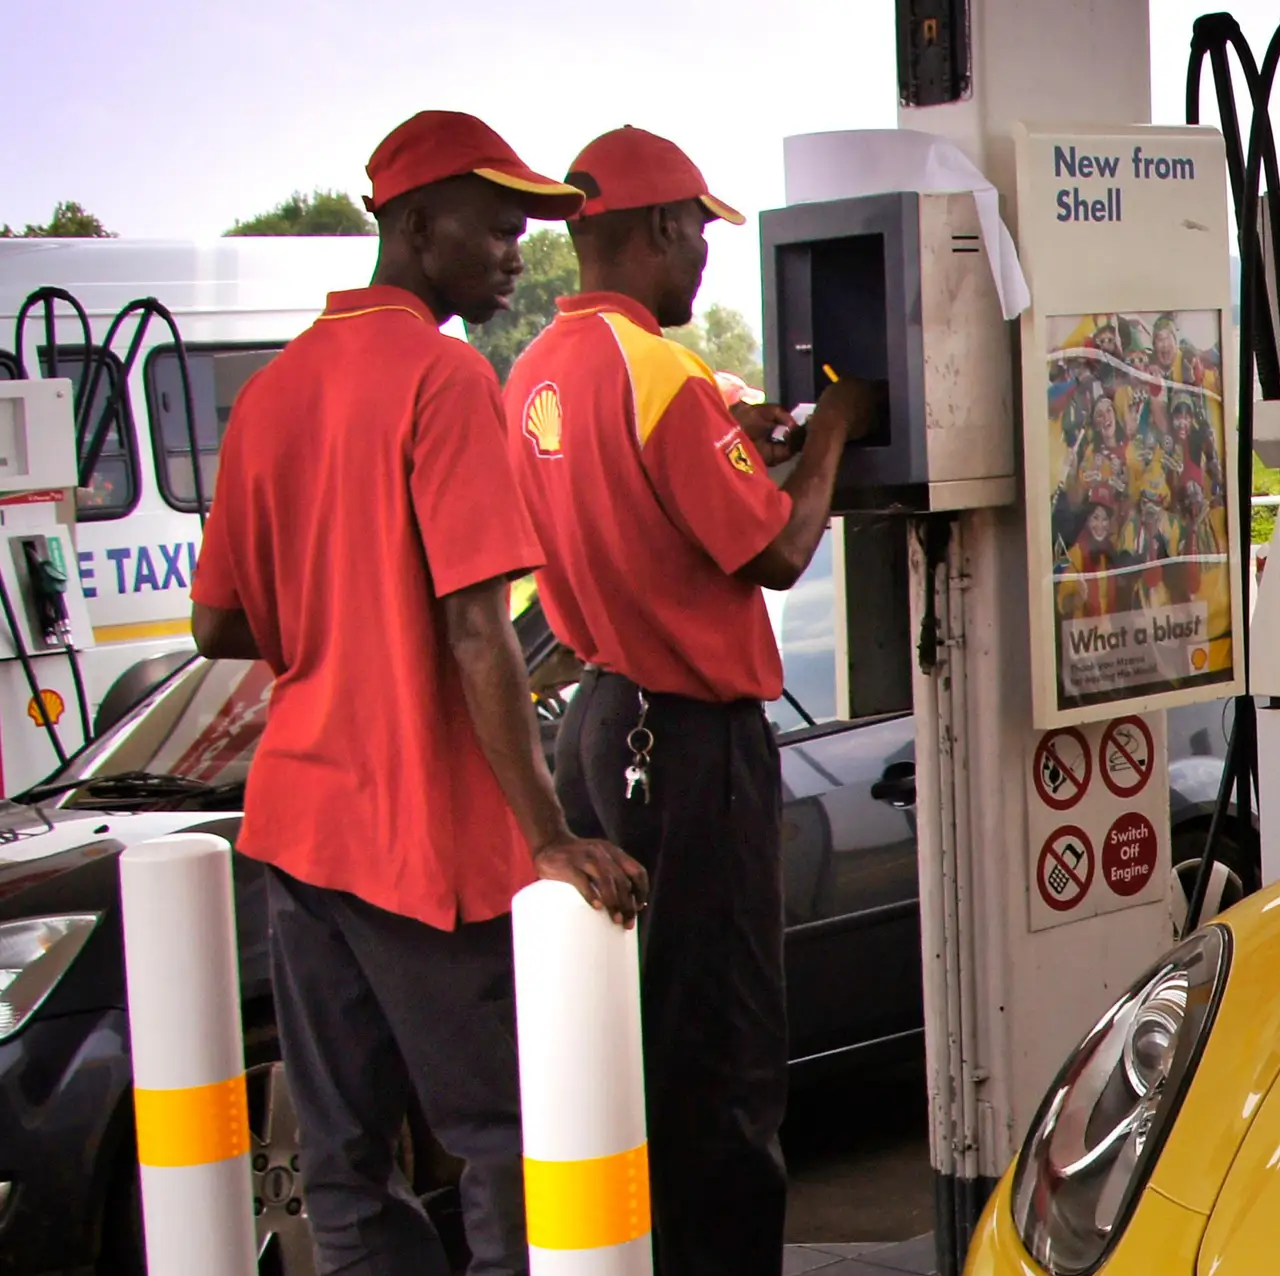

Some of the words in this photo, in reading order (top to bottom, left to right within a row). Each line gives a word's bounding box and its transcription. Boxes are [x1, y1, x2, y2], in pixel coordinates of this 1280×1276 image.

[1054, 145, 1120, 179] New
[1132, 146, 1195, 179] from
[1056, 187, 1122, 222] Shell
[106, 542, 197, 595] TAXI
[1070, 624, 1128, 655] What
[1133, 630, 1147, 645] a
[1152, 614, 1203, 642] blast
[1111, 823, 1148, 844] Switch
[1120, 842, 1140, 860] Off
[1110, 863, 1149, 882] Engine
